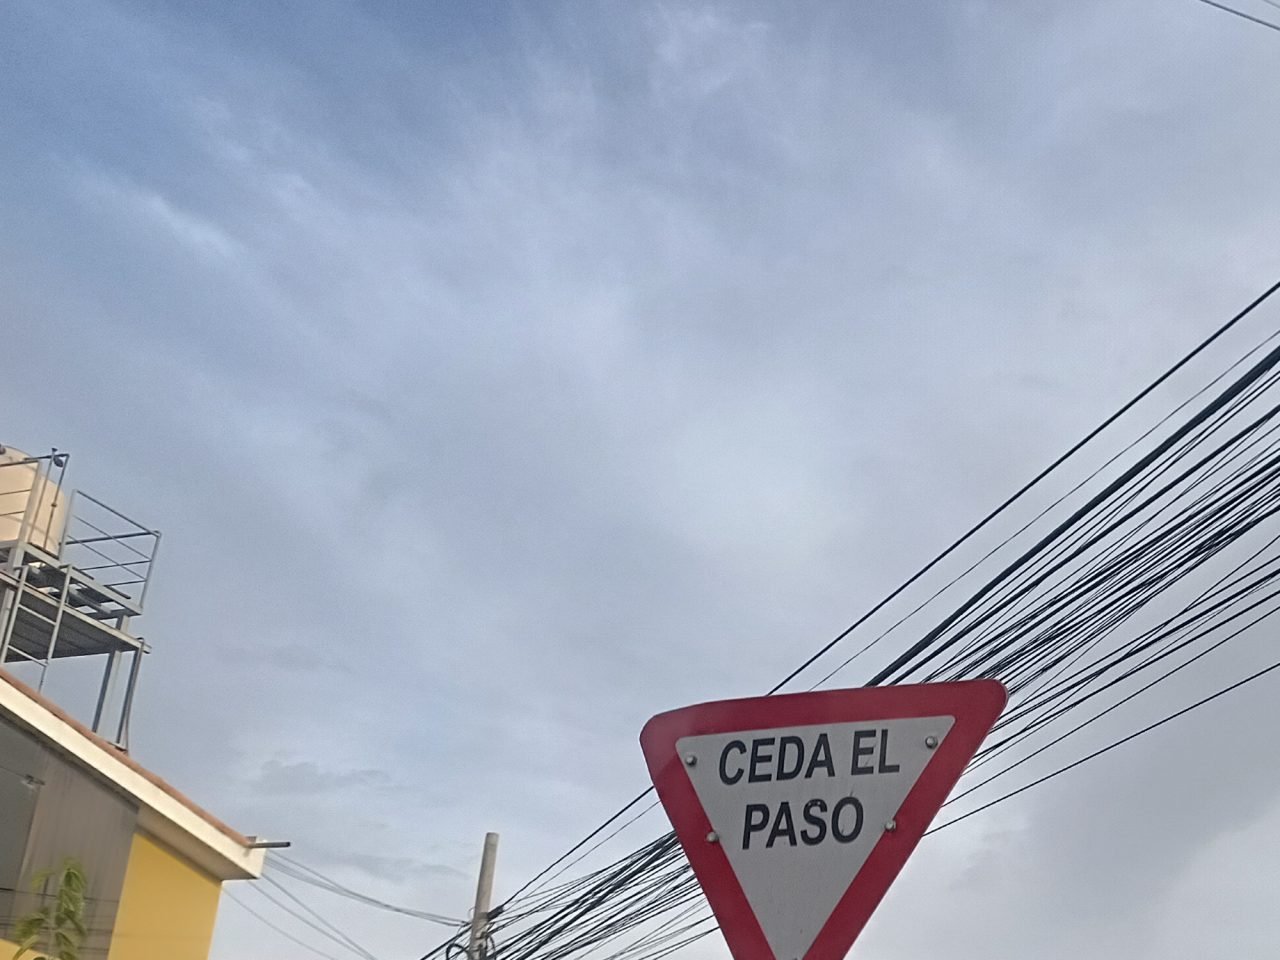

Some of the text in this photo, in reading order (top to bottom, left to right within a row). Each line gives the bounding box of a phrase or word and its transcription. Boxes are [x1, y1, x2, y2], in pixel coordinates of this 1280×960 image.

[718, 728, 900, 786] CEDA EL
[741, 796, 864, 850] PASO
